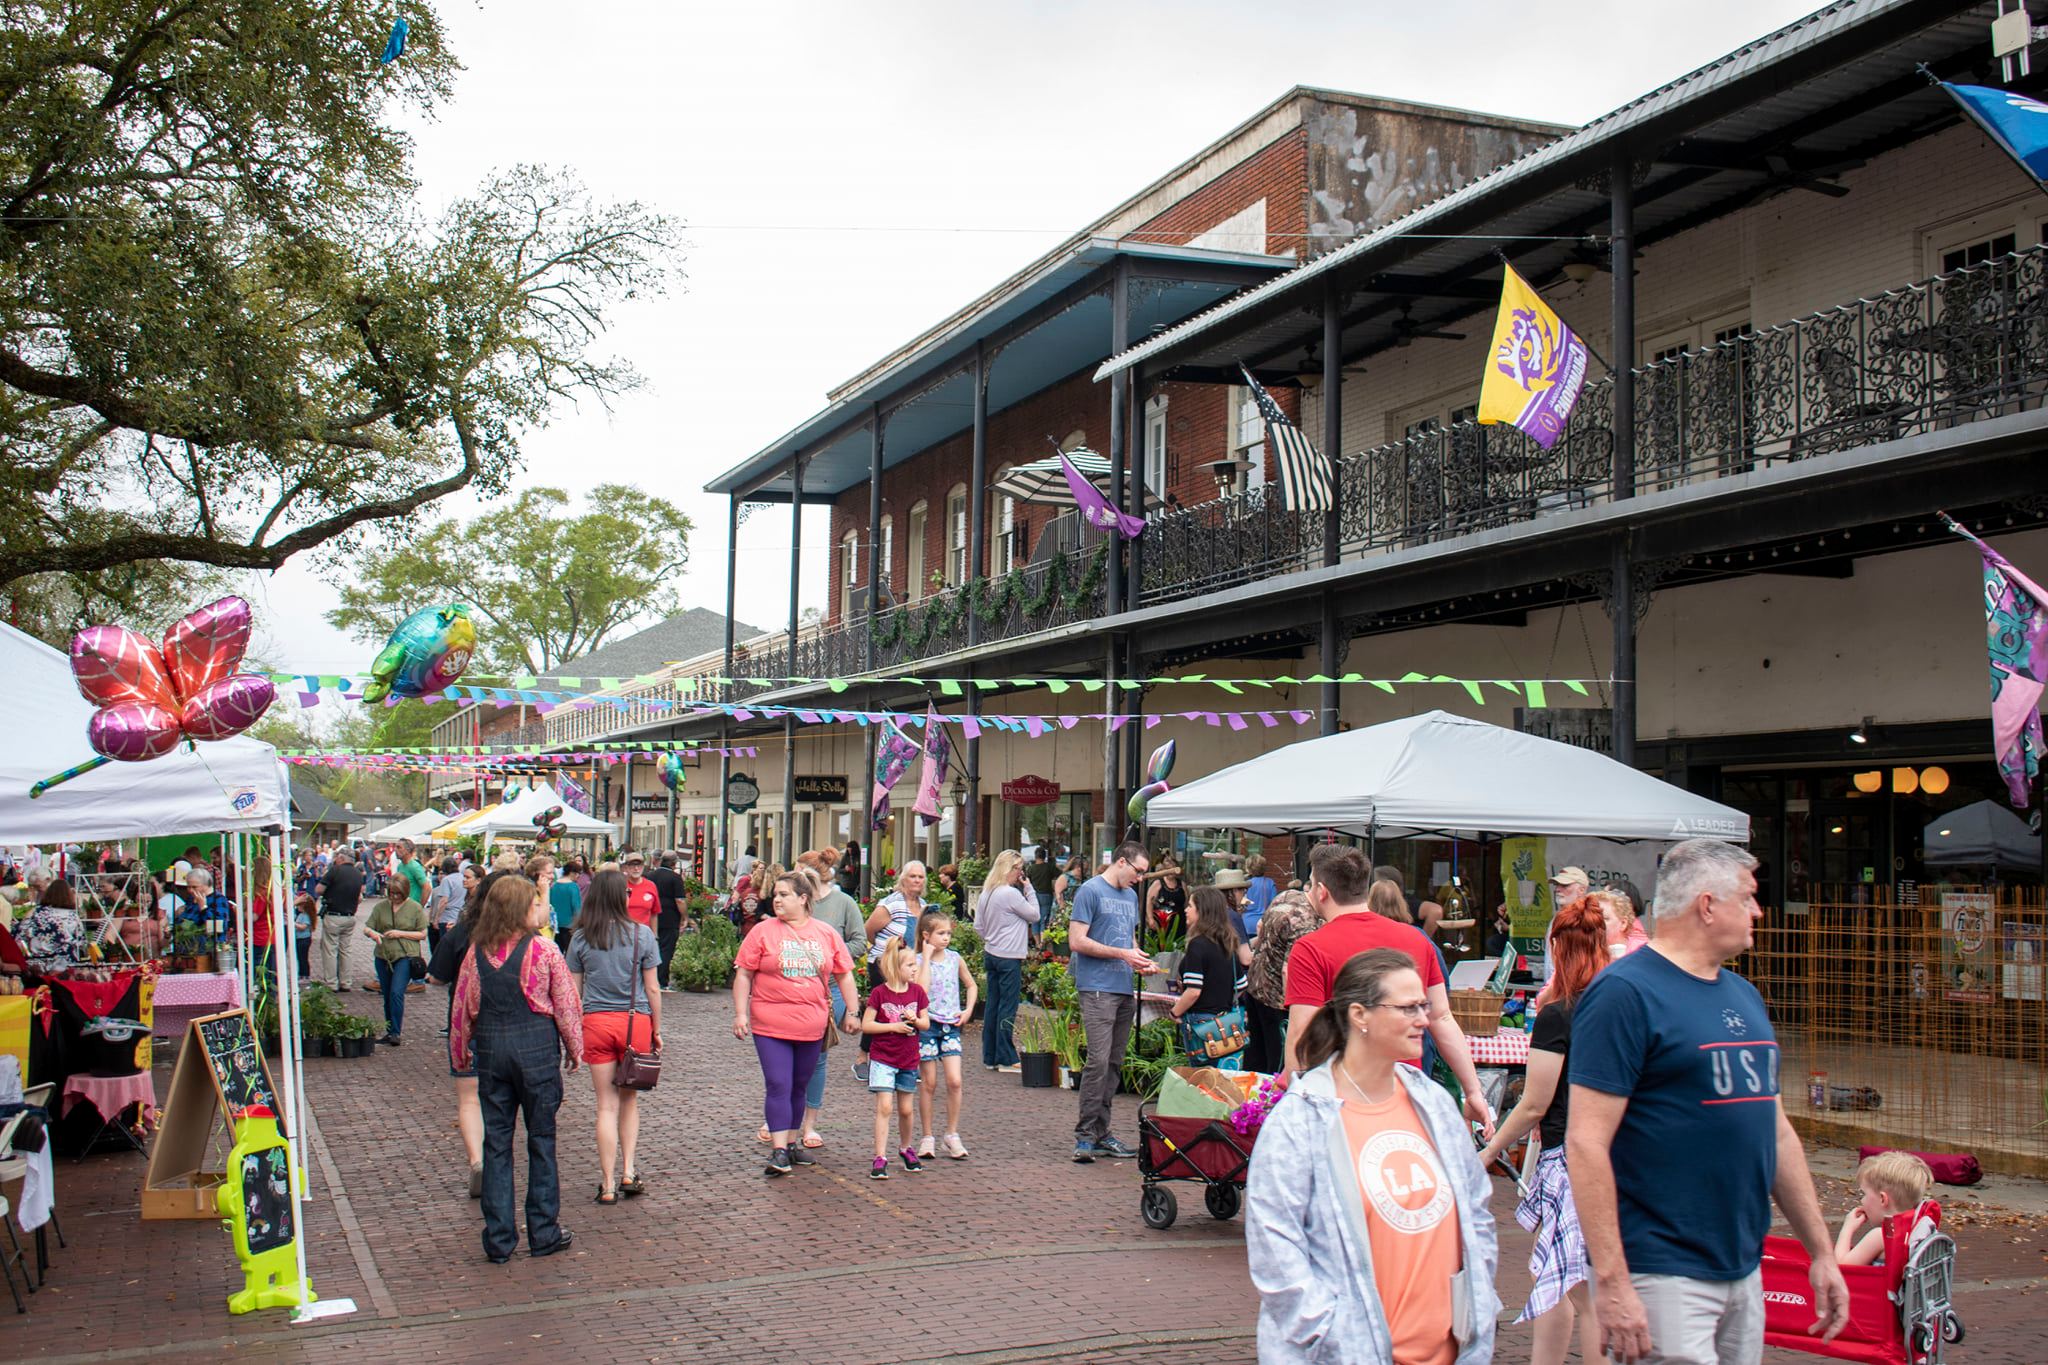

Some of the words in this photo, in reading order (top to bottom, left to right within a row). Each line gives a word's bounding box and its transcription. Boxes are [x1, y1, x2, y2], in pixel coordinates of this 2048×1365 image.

[796, 781, 821, 793] Hello
[821, 780, 845, 795] Dolly
[1004, 786, 1036, 795] DICKENS
[1690, 818, 1736, 833] LEADER
[1511, 905, 1543, 917] Master
[1383, 1162, 1436, 1196] LA
